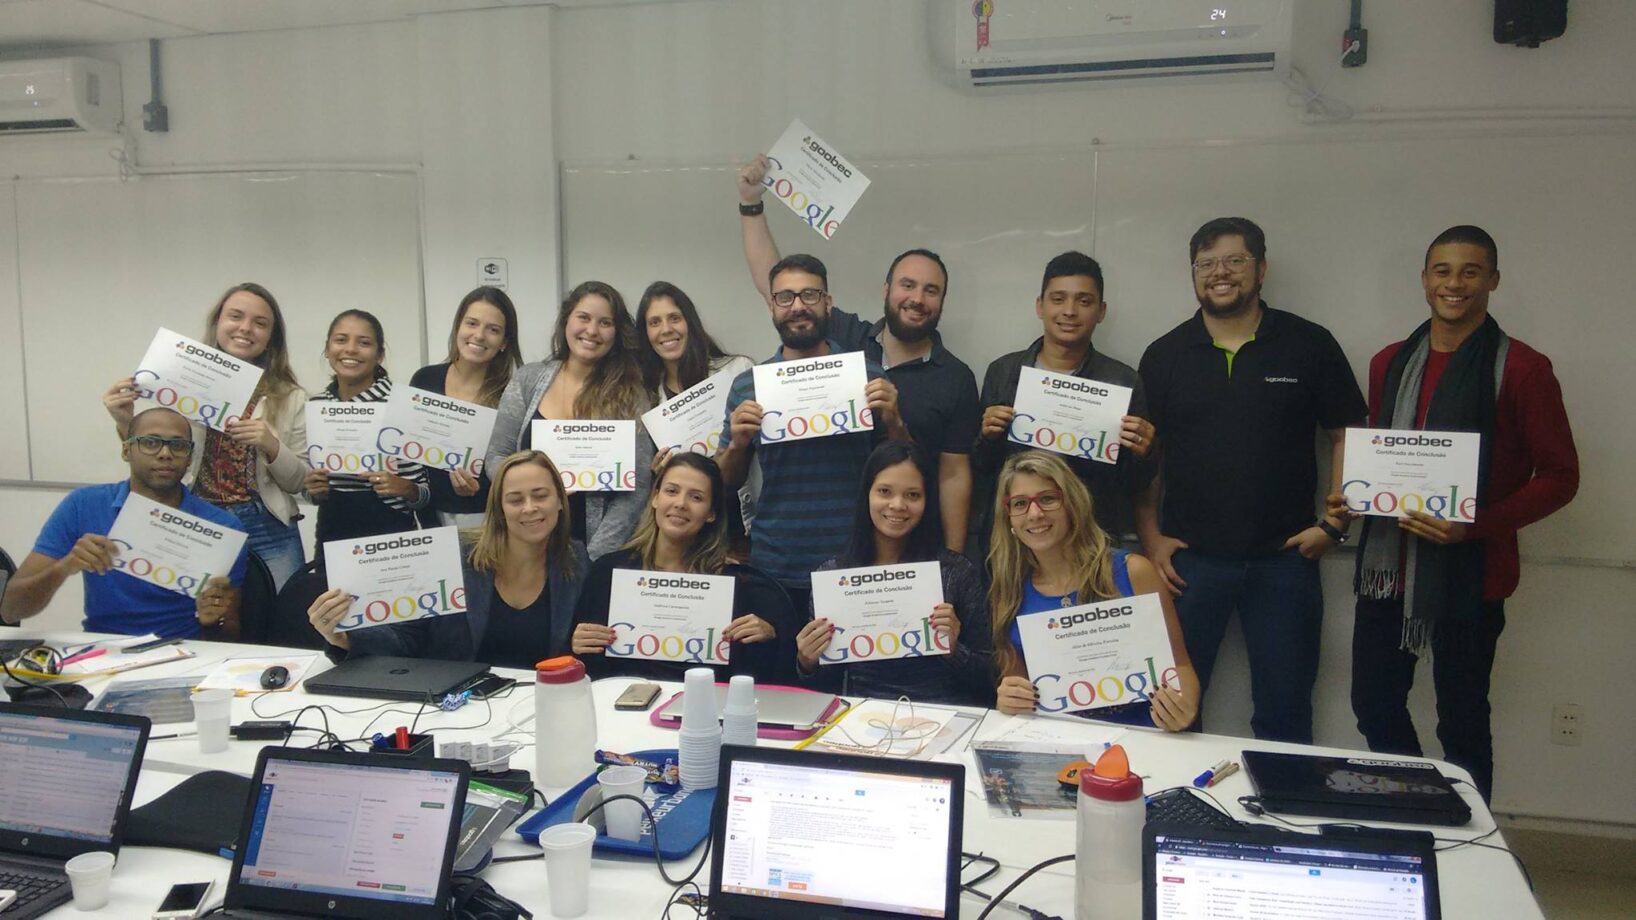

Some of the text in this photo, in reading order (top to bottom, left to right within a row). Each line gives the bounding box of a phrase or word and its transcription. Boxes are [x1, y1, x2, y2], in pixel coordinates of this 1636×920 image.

[1210, 9, 1227, 20] 24
[809, 141, 853, 178] goobec
[185, 344, 241, 372] goobec
[786, 360, 843, 377] goobec
[669, 382, 715, 413] goobec
[1052, 379, 1109, 397] goobec
[328, 405, 375, 416] goobec
[421, 396, 477, 417] goobec
[760, 399, 874, 442] Google
[562, 423, 616, 434] goobec
[1008, 413, 1120, 461] Google
[1384, 435, 1453, 447] goobec
[307, 444, 399, 473] Google
[376, 426, 485, 476] Google
[560, 462, 636, 491] oogle
[1342, 480, 1477, 520] Google
[160, 512, 224, 540] goobec
[364, 535, 433, 555] goobec
[108, 538, 212, 597] Googl
[850, 569, 916, 587] goobec
[648, 577, 711, 590] goobec
[844, 588, 874, 597] Certificado
[1060, 605, 1133, 629] goobec
[606, 622, 730, 664] Google
[820, 617, 950, 663] Google
[1055, 630, 1088, 640] Certificado
[1033, 656, 1183, 713] Google
